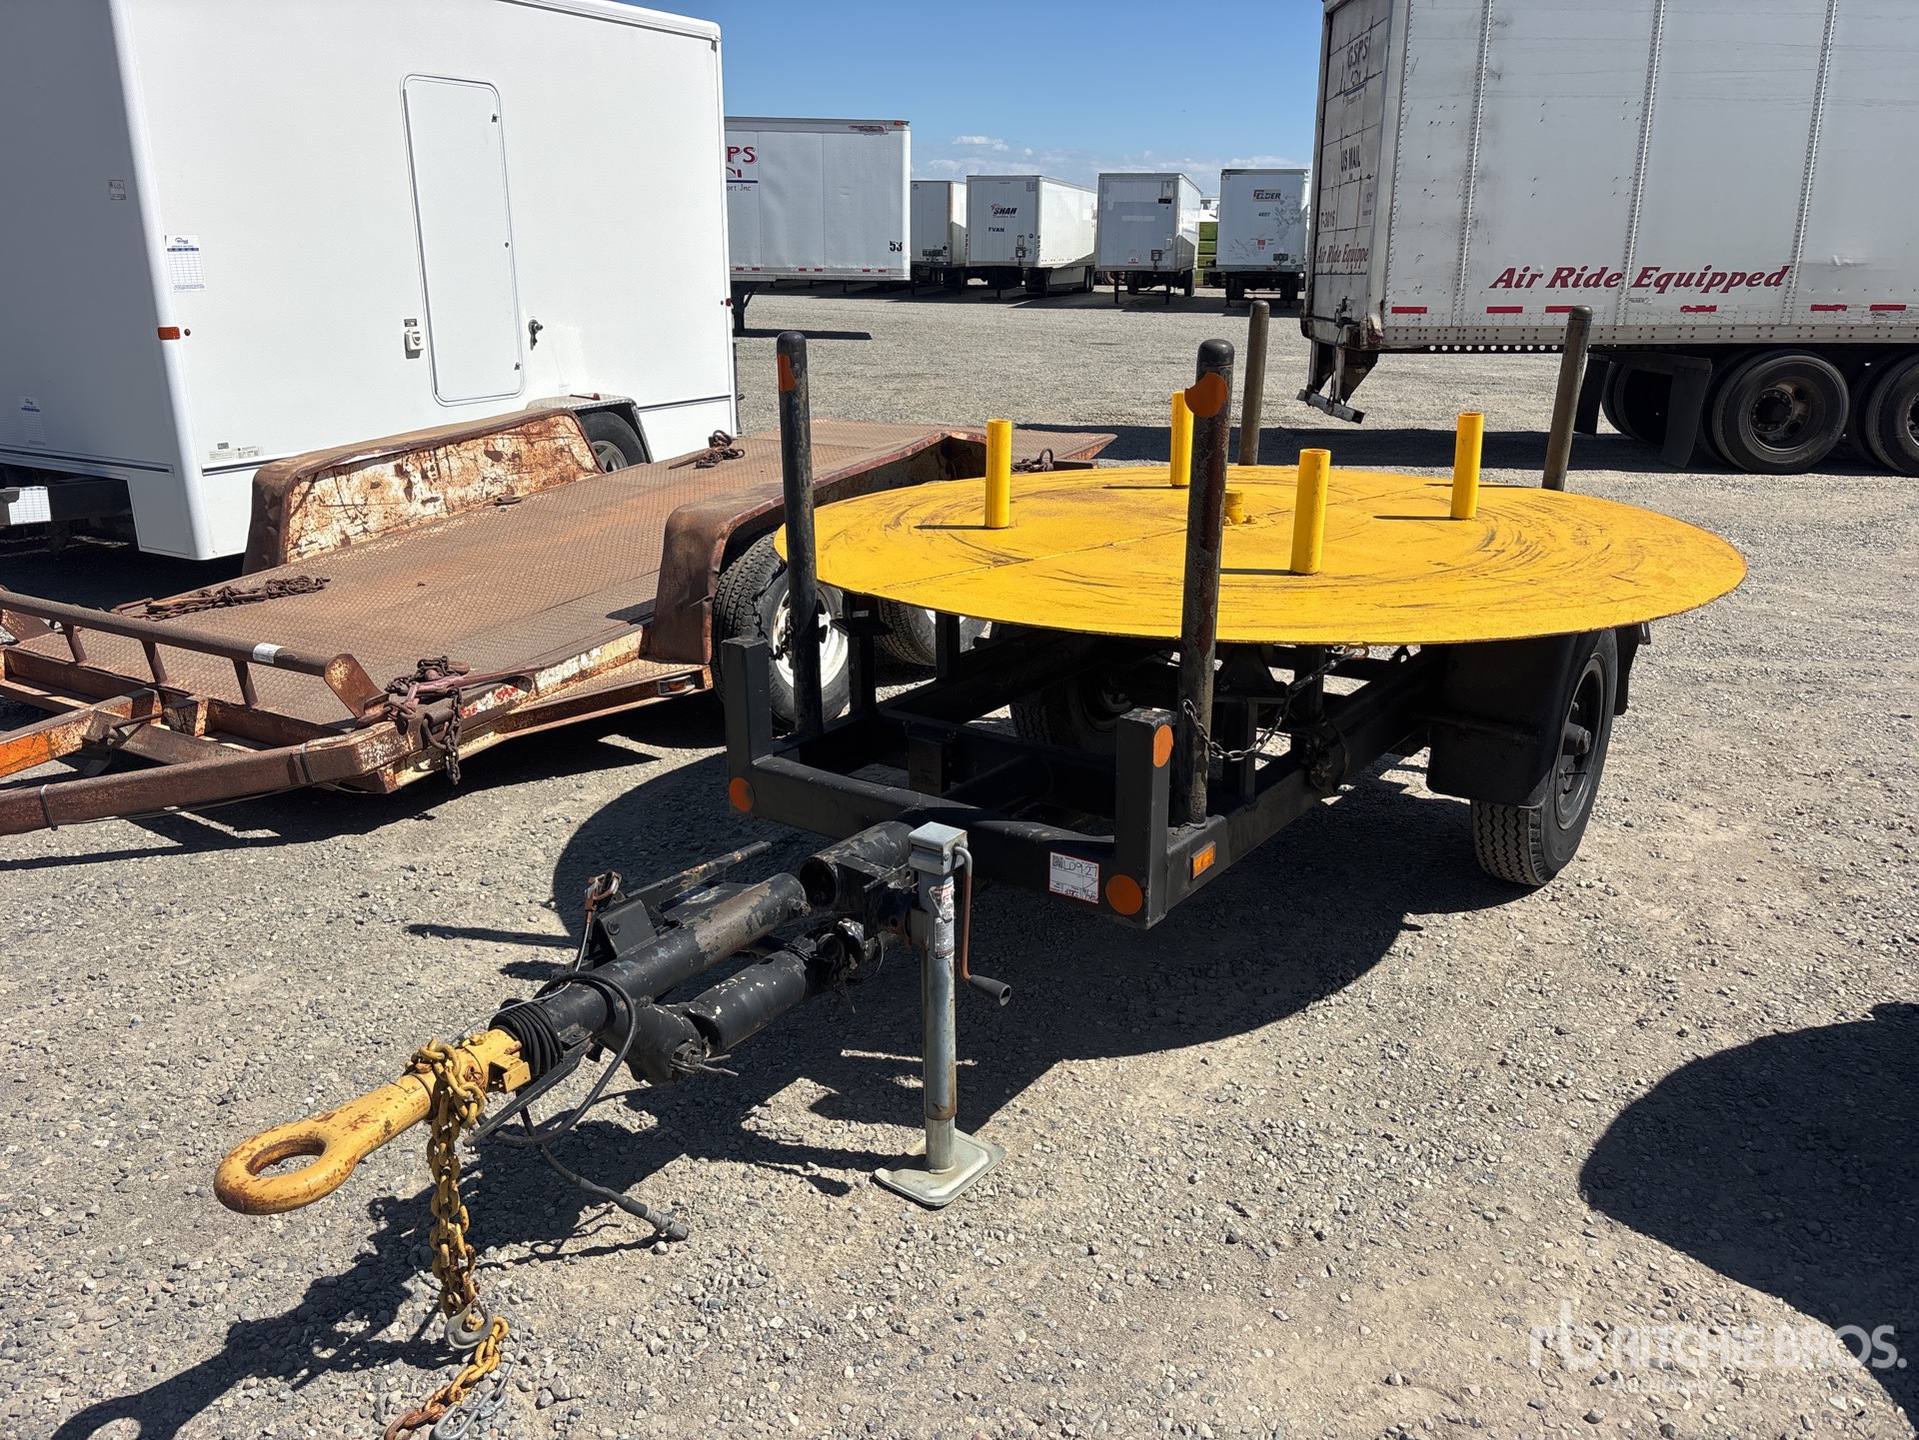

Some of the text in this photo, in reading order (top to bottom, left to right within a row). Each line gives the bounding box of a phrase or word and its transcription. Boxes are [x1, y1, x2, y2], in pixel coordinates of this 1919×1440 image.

[727, 146, 758, 164] PS
[1341, 145, 1361, 172] US MAIL
[889, 241, 903, 252] 53
[1327, 244, 1342, 263] Ride
[1342, 242, 1369, 269] Equippe
[1489, 264, 1791, 294] Air Ride Equipped
